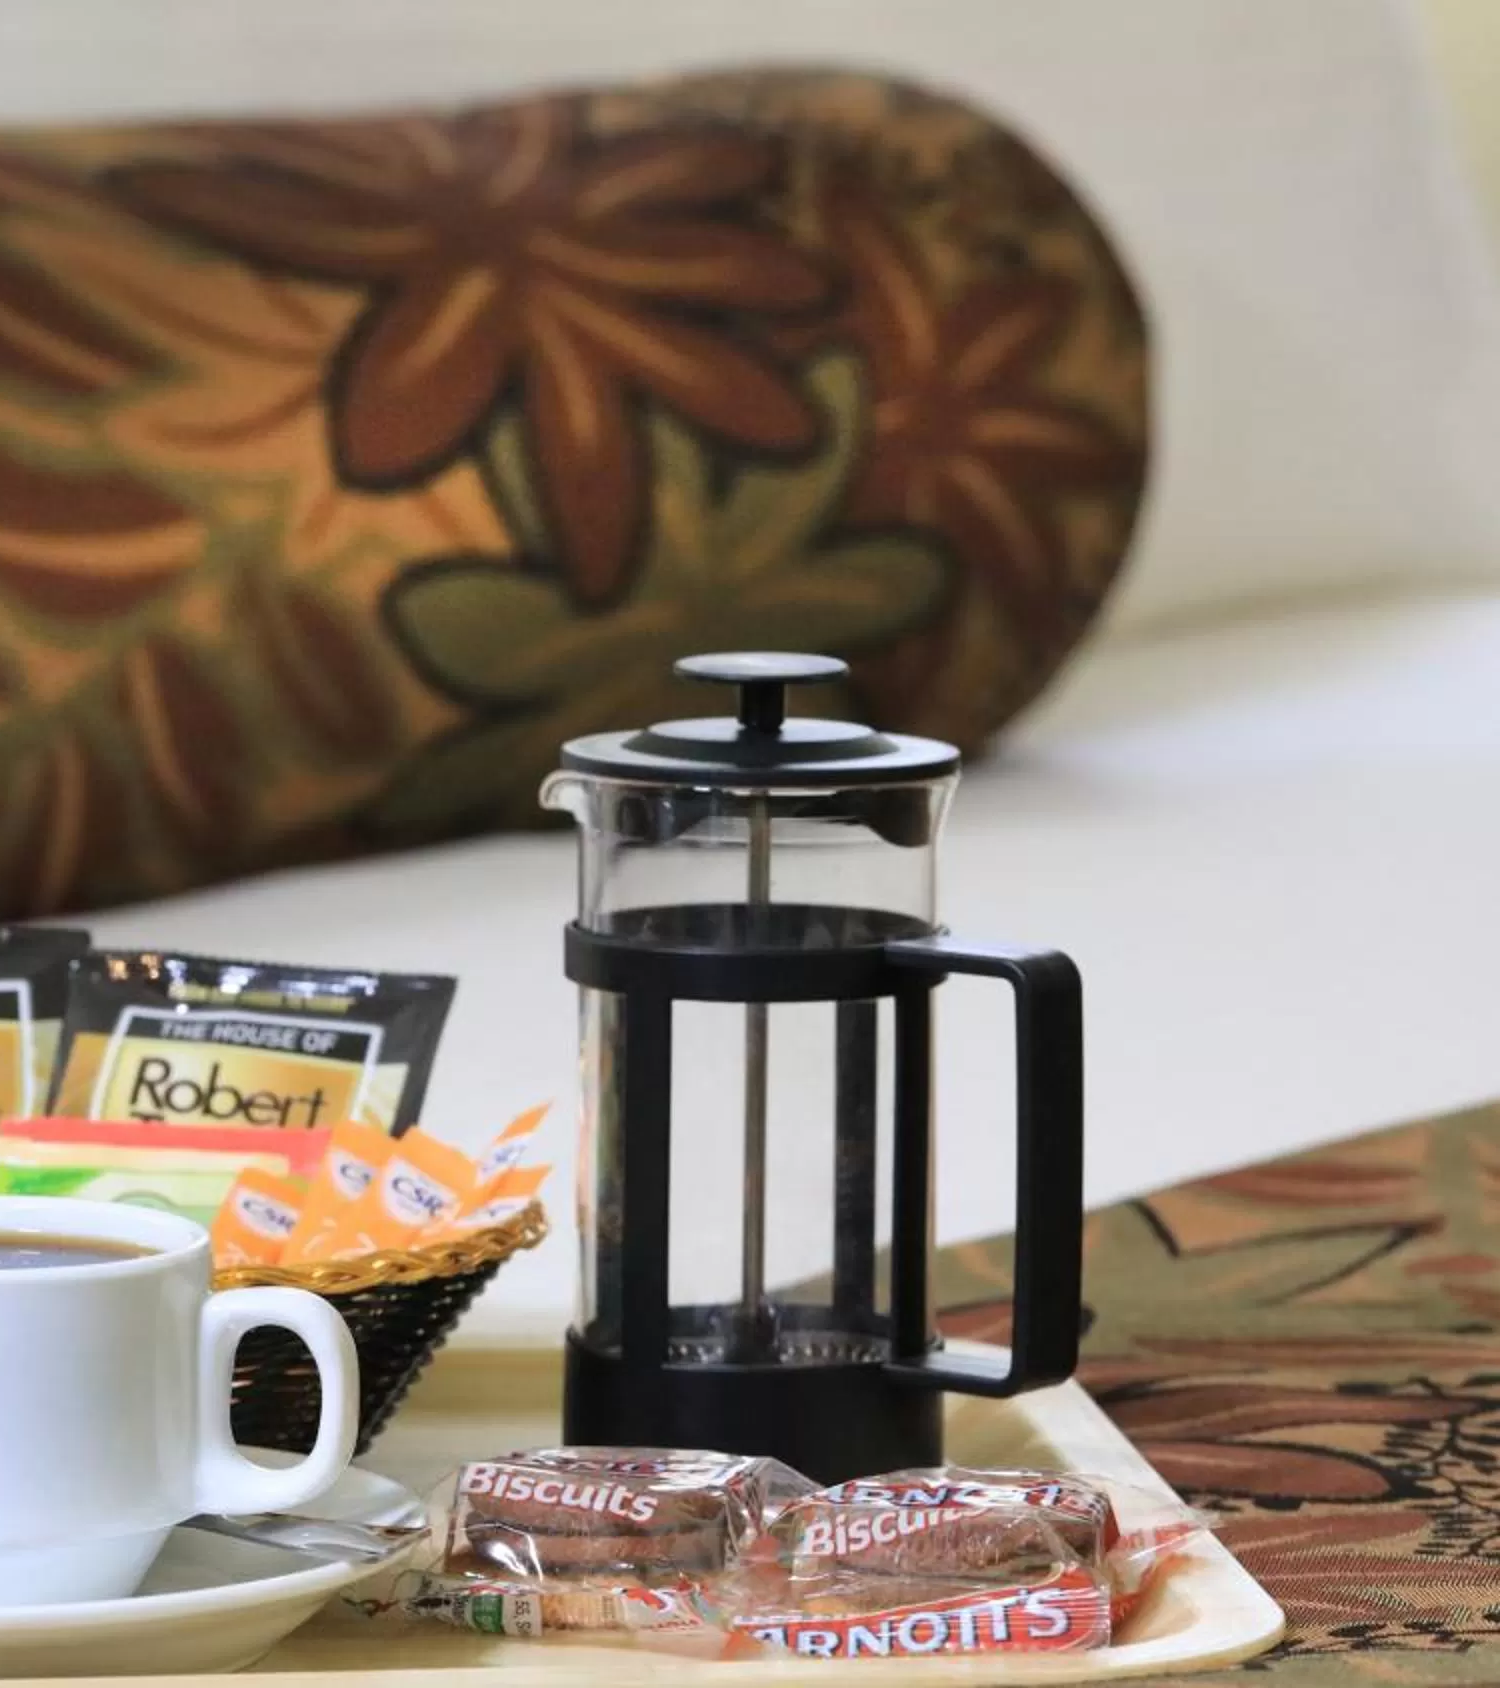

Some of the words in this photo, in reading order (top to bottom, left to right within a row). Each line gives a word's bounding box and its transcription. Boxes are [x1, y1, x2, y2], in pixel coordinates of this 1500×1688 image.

[160, 1020, 206, 1039] THE
[212, 1022, 299, 1048] HOUSE
[302, 1032, 340, 1054] OF
[130, 1057, 327, 1129] Robert
[460, 1463, 658, 1523] Biscuits
